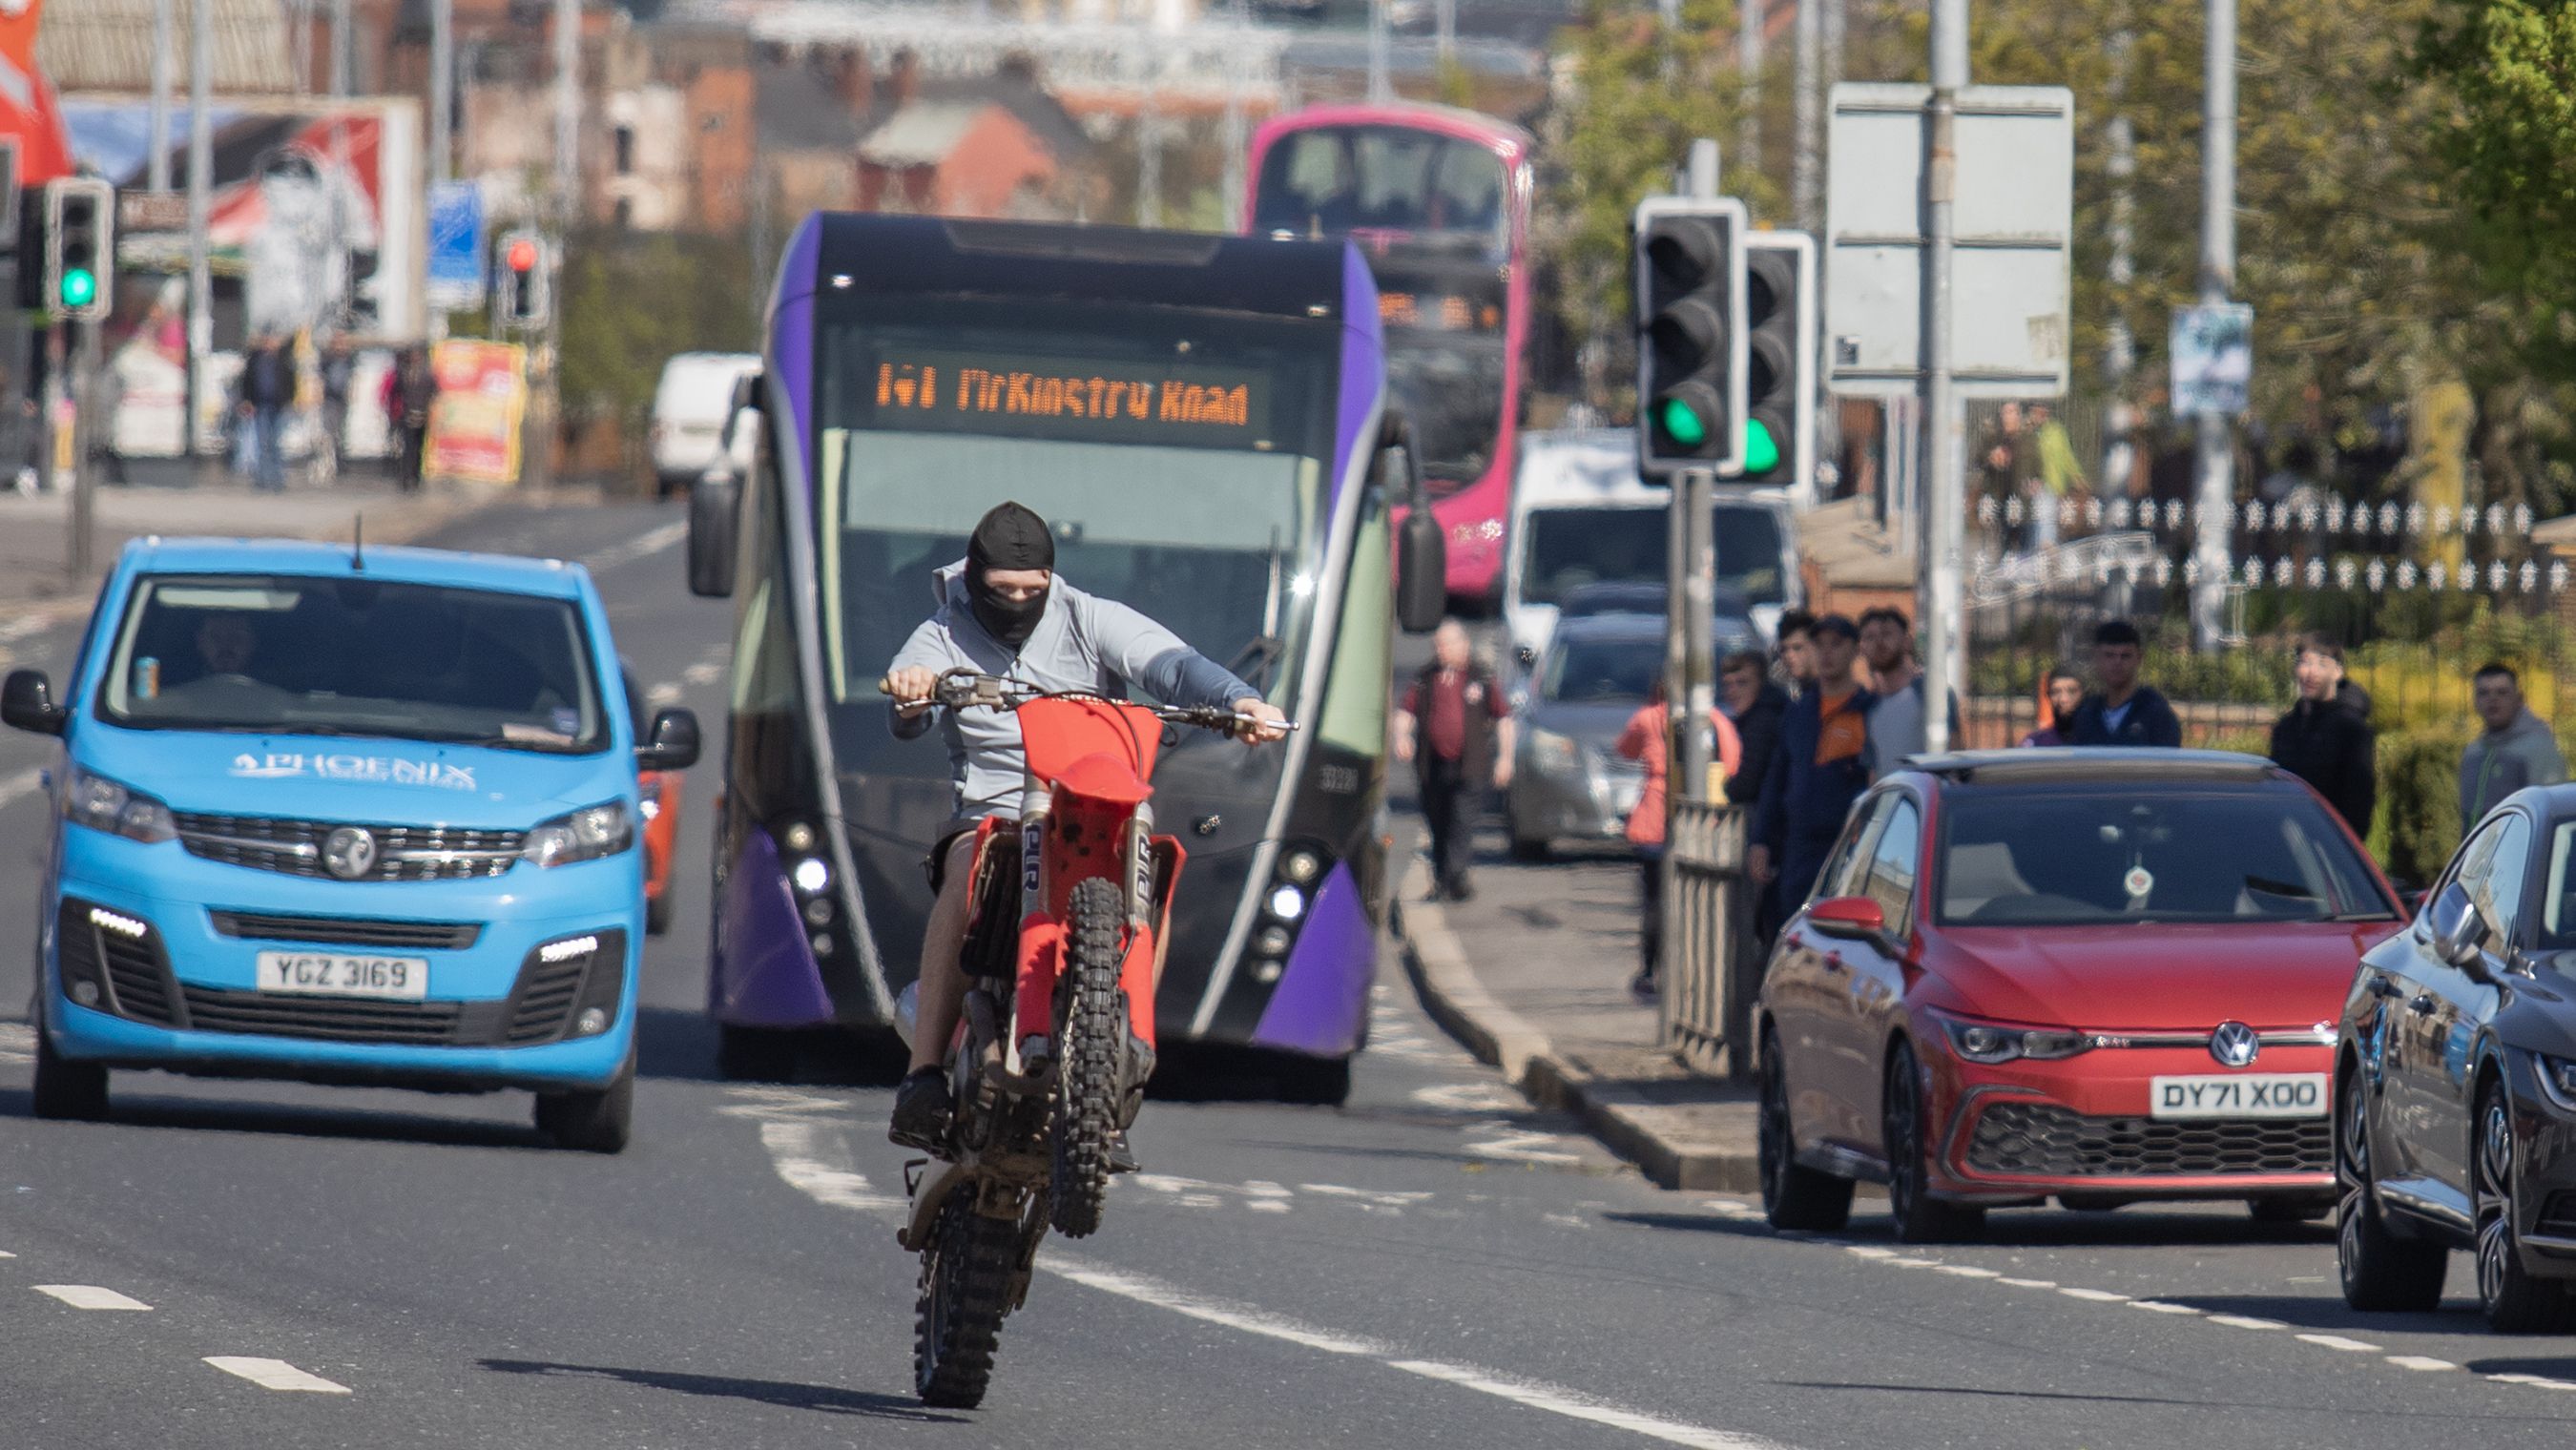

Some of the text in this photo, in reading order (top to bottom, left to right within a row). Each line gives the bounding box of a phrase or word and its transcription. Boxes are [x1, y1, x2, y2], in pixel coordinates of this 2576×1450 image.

[266, 753, 476, 788] PHOENIX
[277, 956, 407, 988] YGZ 3169
[2164, 1083, 2241, 1107] DY71
